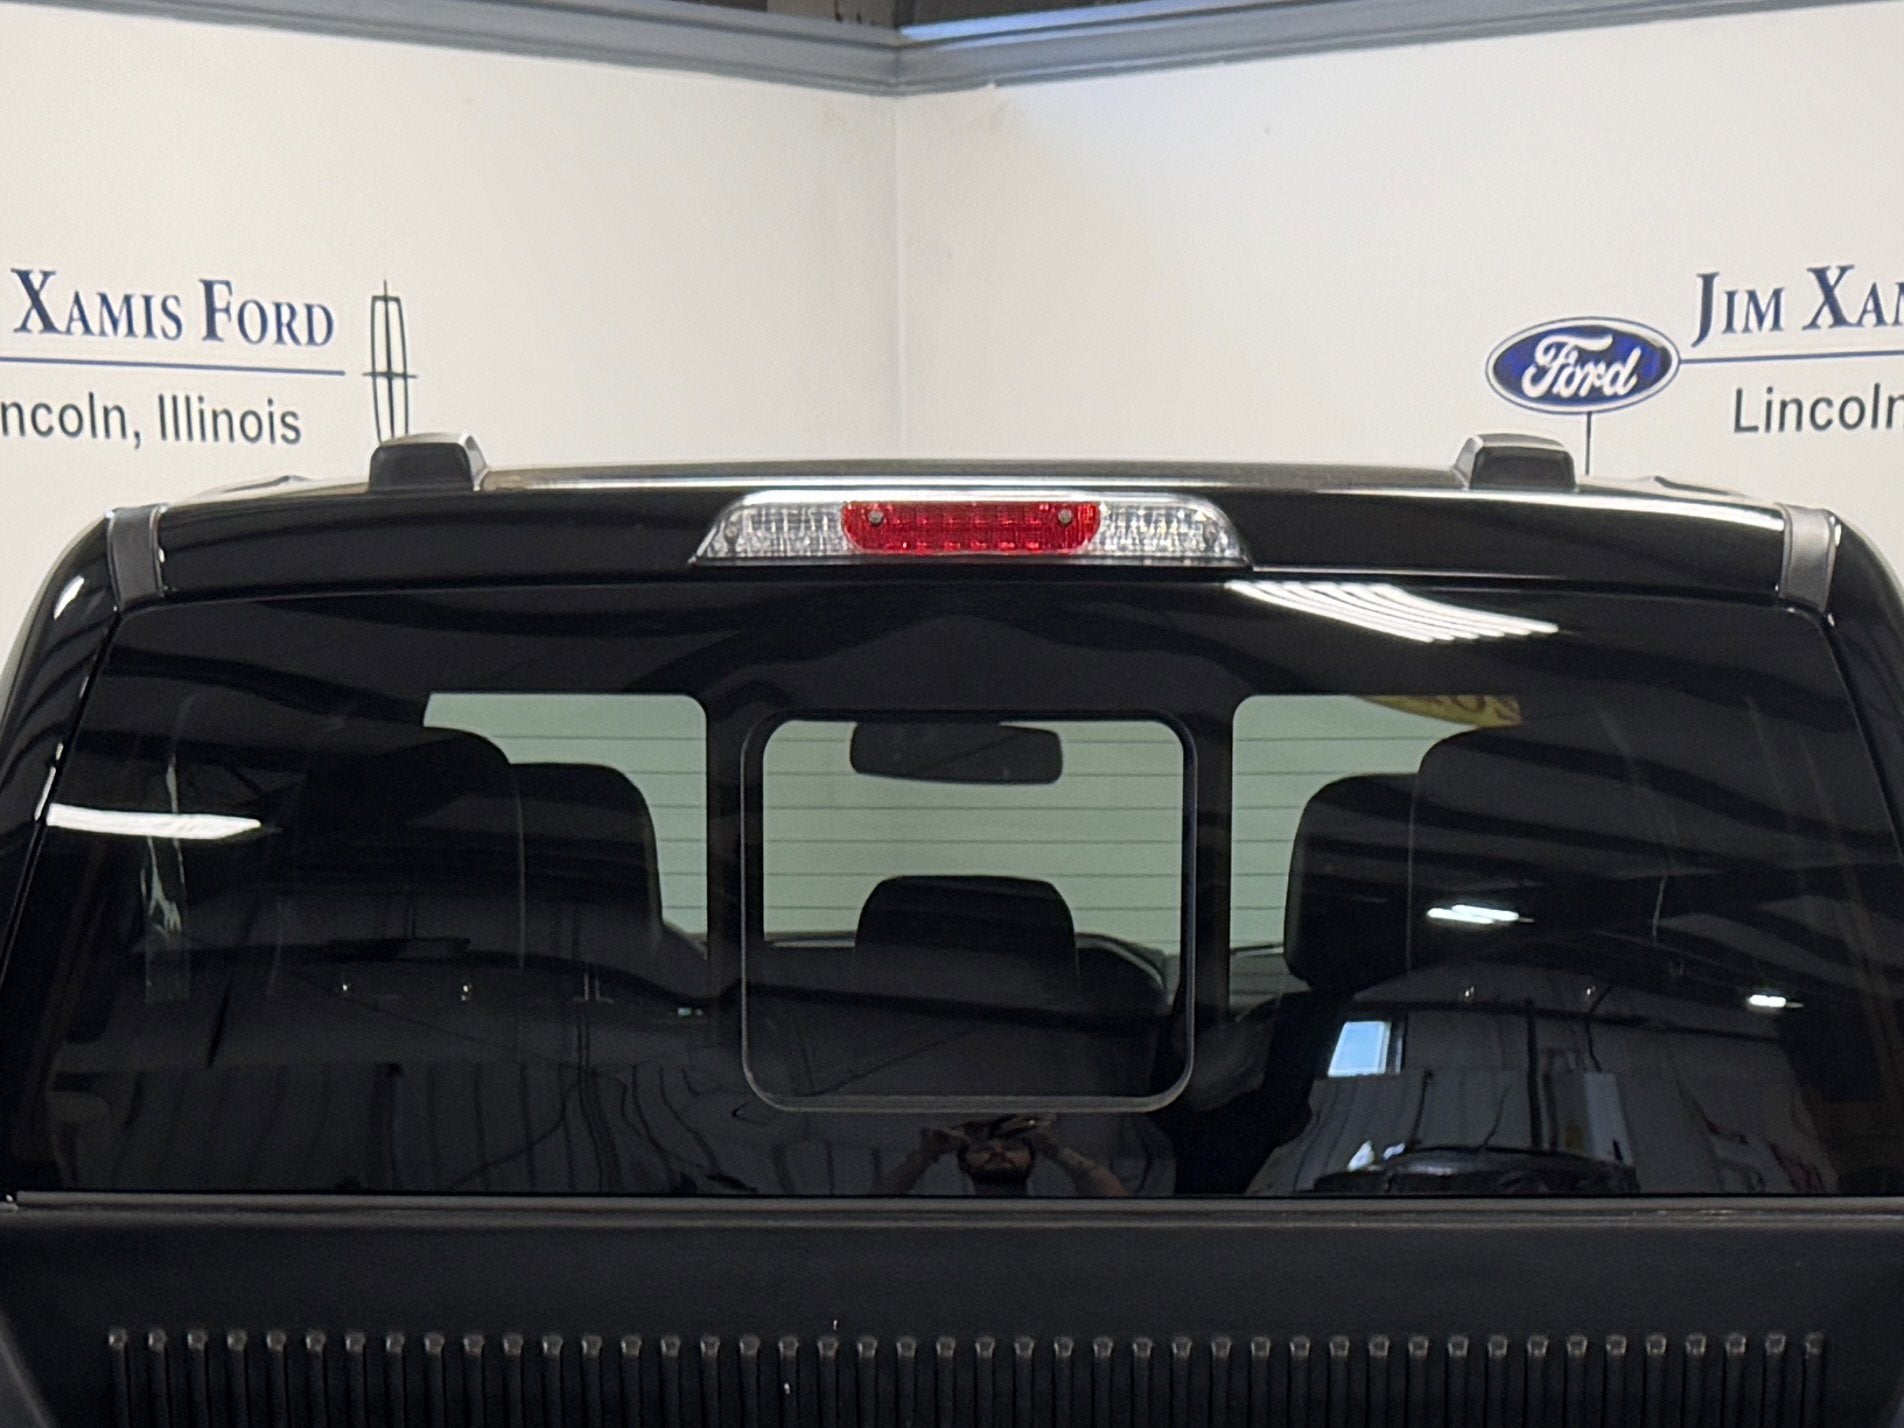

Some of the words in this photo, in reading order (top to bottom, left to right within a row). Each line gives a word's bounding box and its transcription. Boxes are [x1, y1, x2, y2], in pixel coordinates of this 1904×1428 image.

[10, 268, 183, 340] XAMIS
[199, 279, 334, 346] FORD
[1692, 271, 1784, 348] JIM
[1520, 334, 1638, 399] Ford
[159, 393, 301, 445] Illinois
